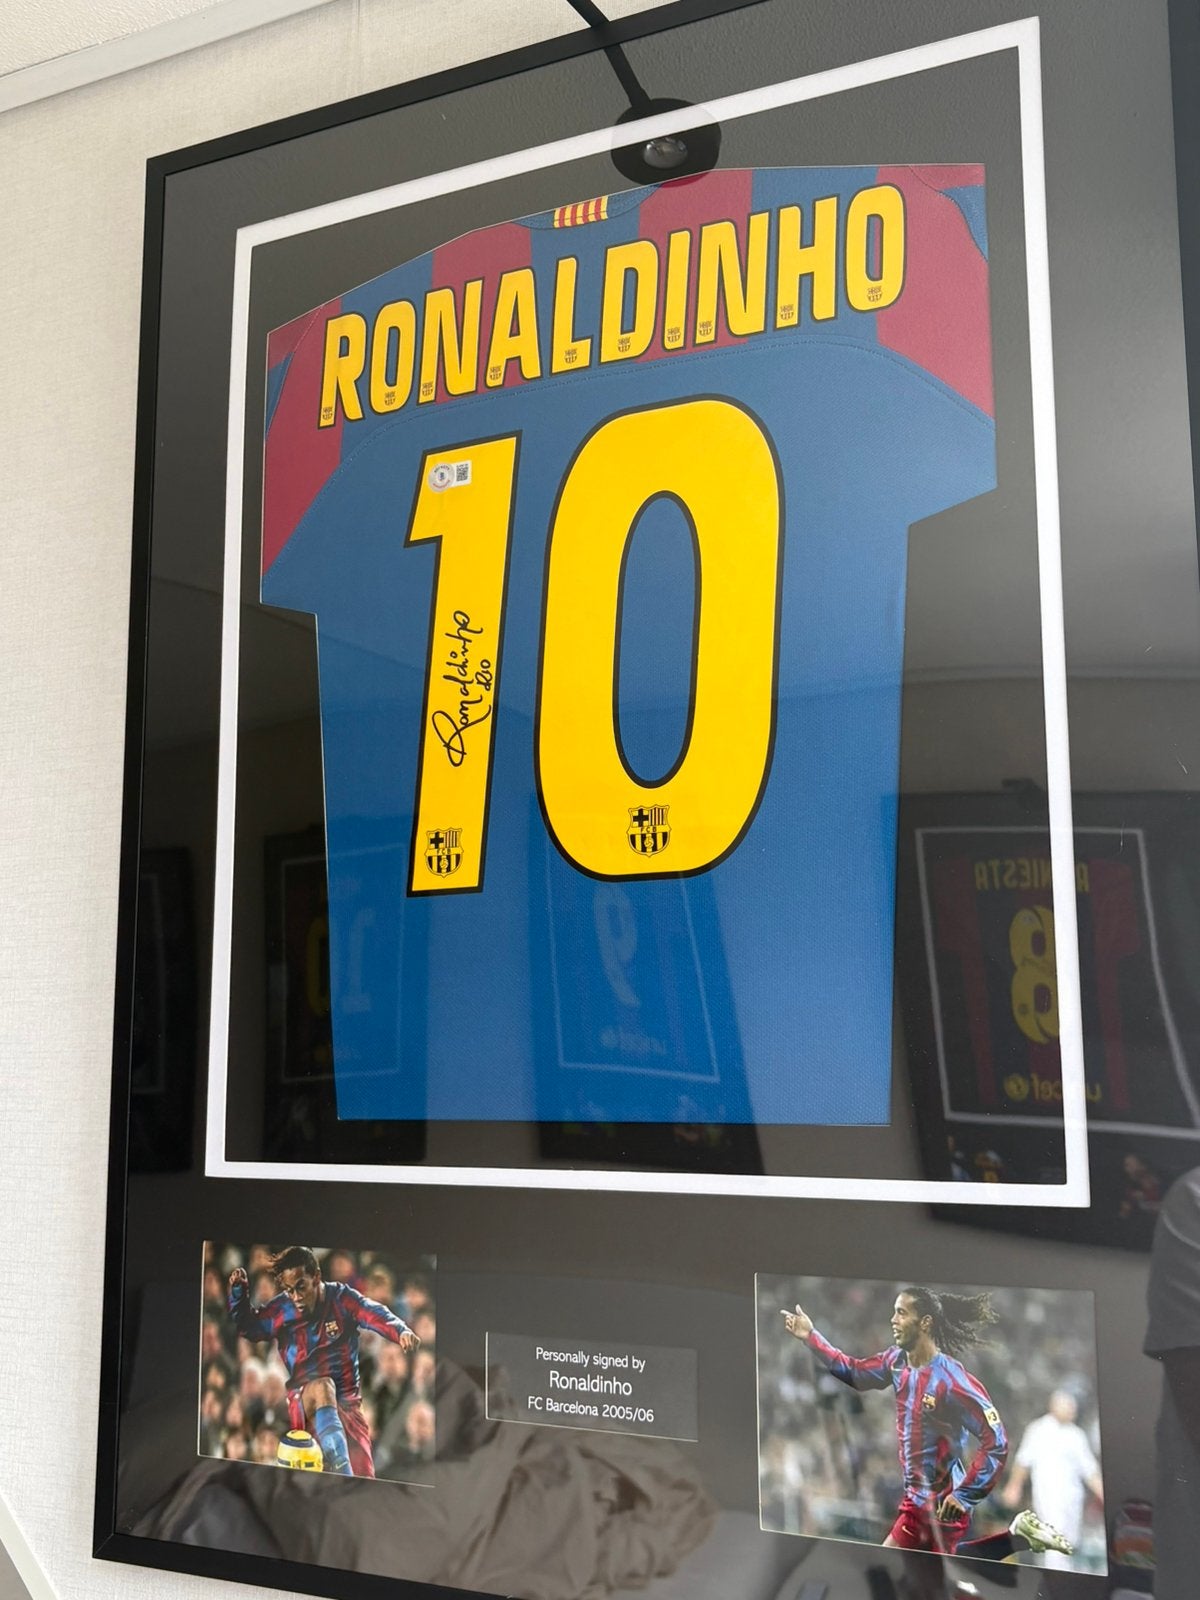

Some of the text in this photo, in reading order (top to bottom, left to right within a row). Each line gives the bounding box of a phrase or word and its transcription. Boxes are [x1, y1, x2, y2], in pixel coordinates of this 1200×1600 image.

[318, 183, 907, 429] RONALDINHO
[403, 392, 786, 898] 10
[535, 1346, 646, 1373] Personally signed by
[549, 1370, 633, 1396] Ronaldinho
[528, 1395, 655, 1423] FC Barcelona 2005/06
